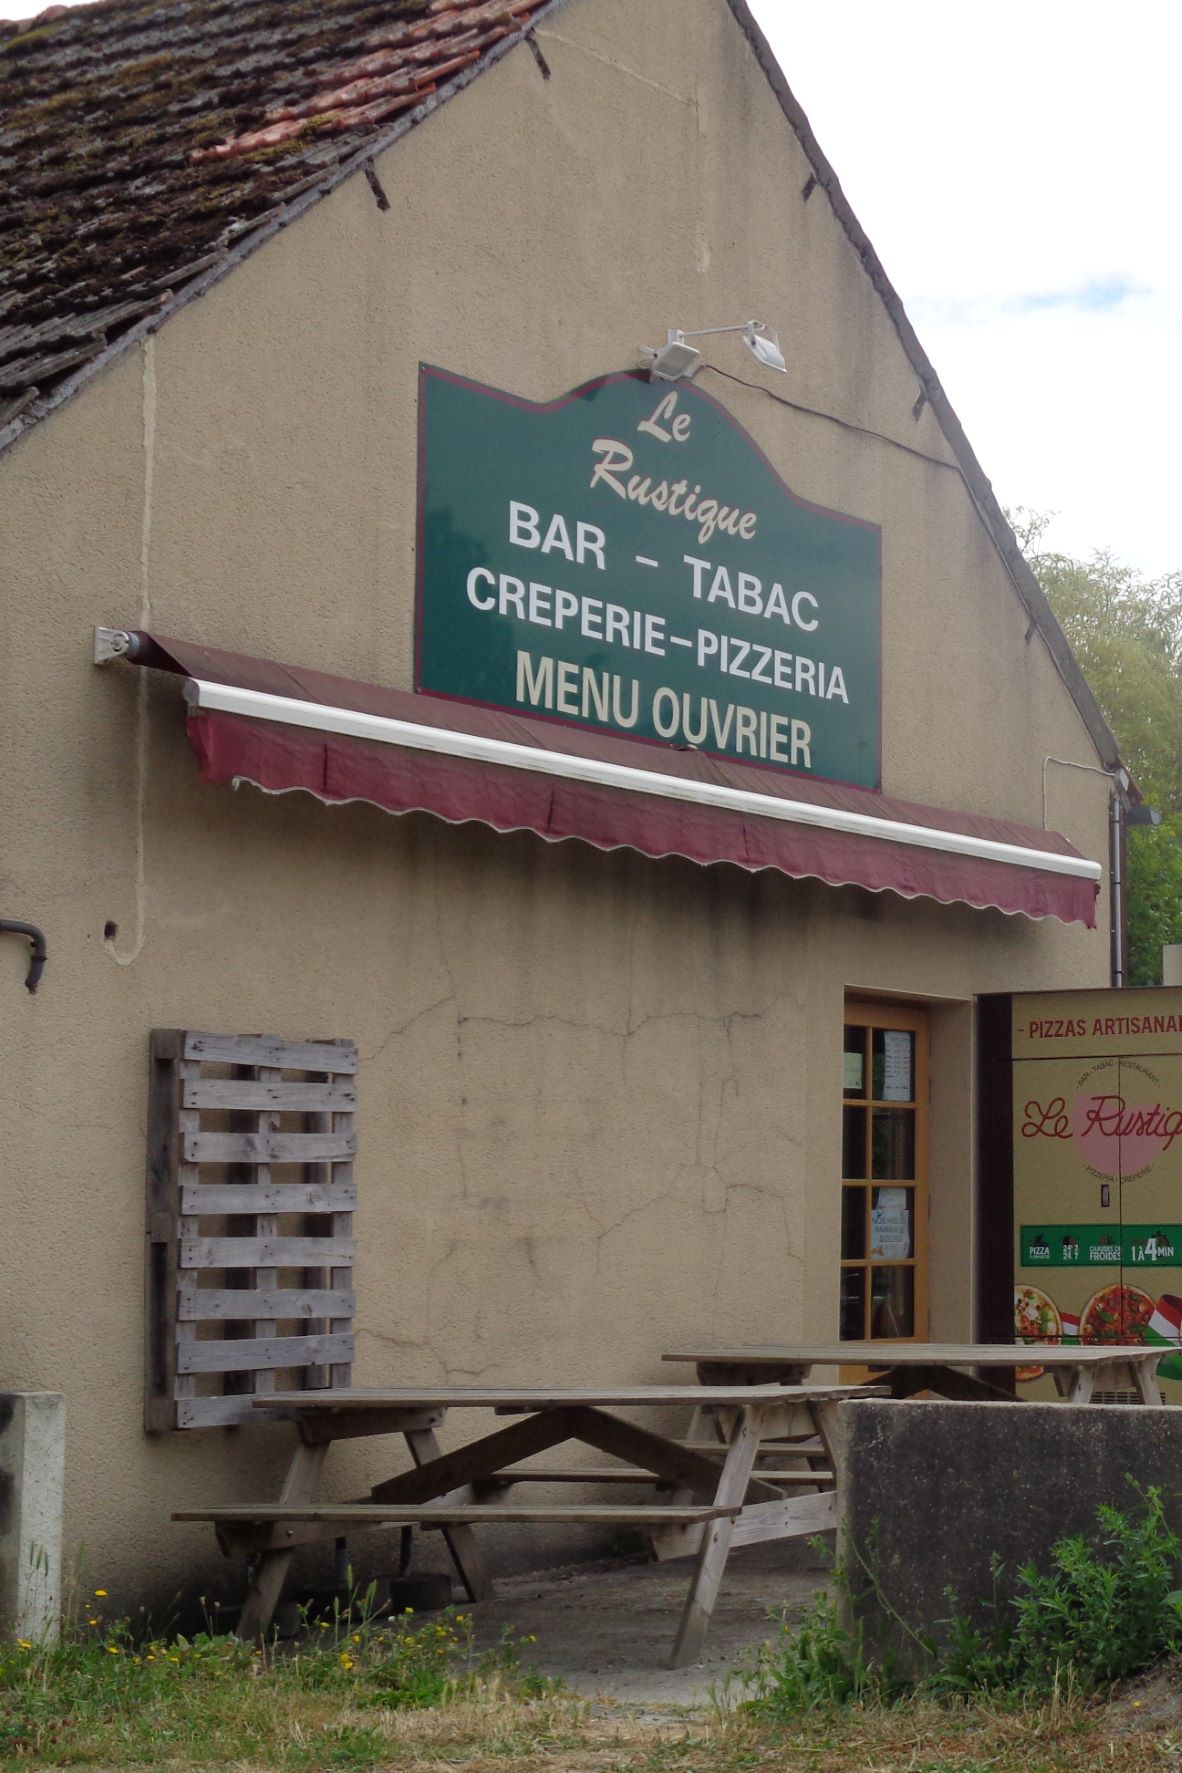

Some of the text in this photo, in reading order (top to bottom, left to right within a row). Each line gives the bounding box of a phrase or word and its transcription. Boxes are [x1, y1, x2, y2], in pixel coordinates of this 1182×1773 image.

[637, 391, 690, 442] Le
[590, 438, 757, 544] Rustique
[509, 500, 606, 569] BAR
[683, 554, 819, 632] TABAC
[515, 650, 812, 768] MENU OUVRIER
[1029, 1019, 1086, 1038] PIZZAS
[1021, 1097, 1074, 1139] Le
[1029, 1246, 1050, 1255] PIZZA
[1089, 1252, 1121, 1261] FROIDES
